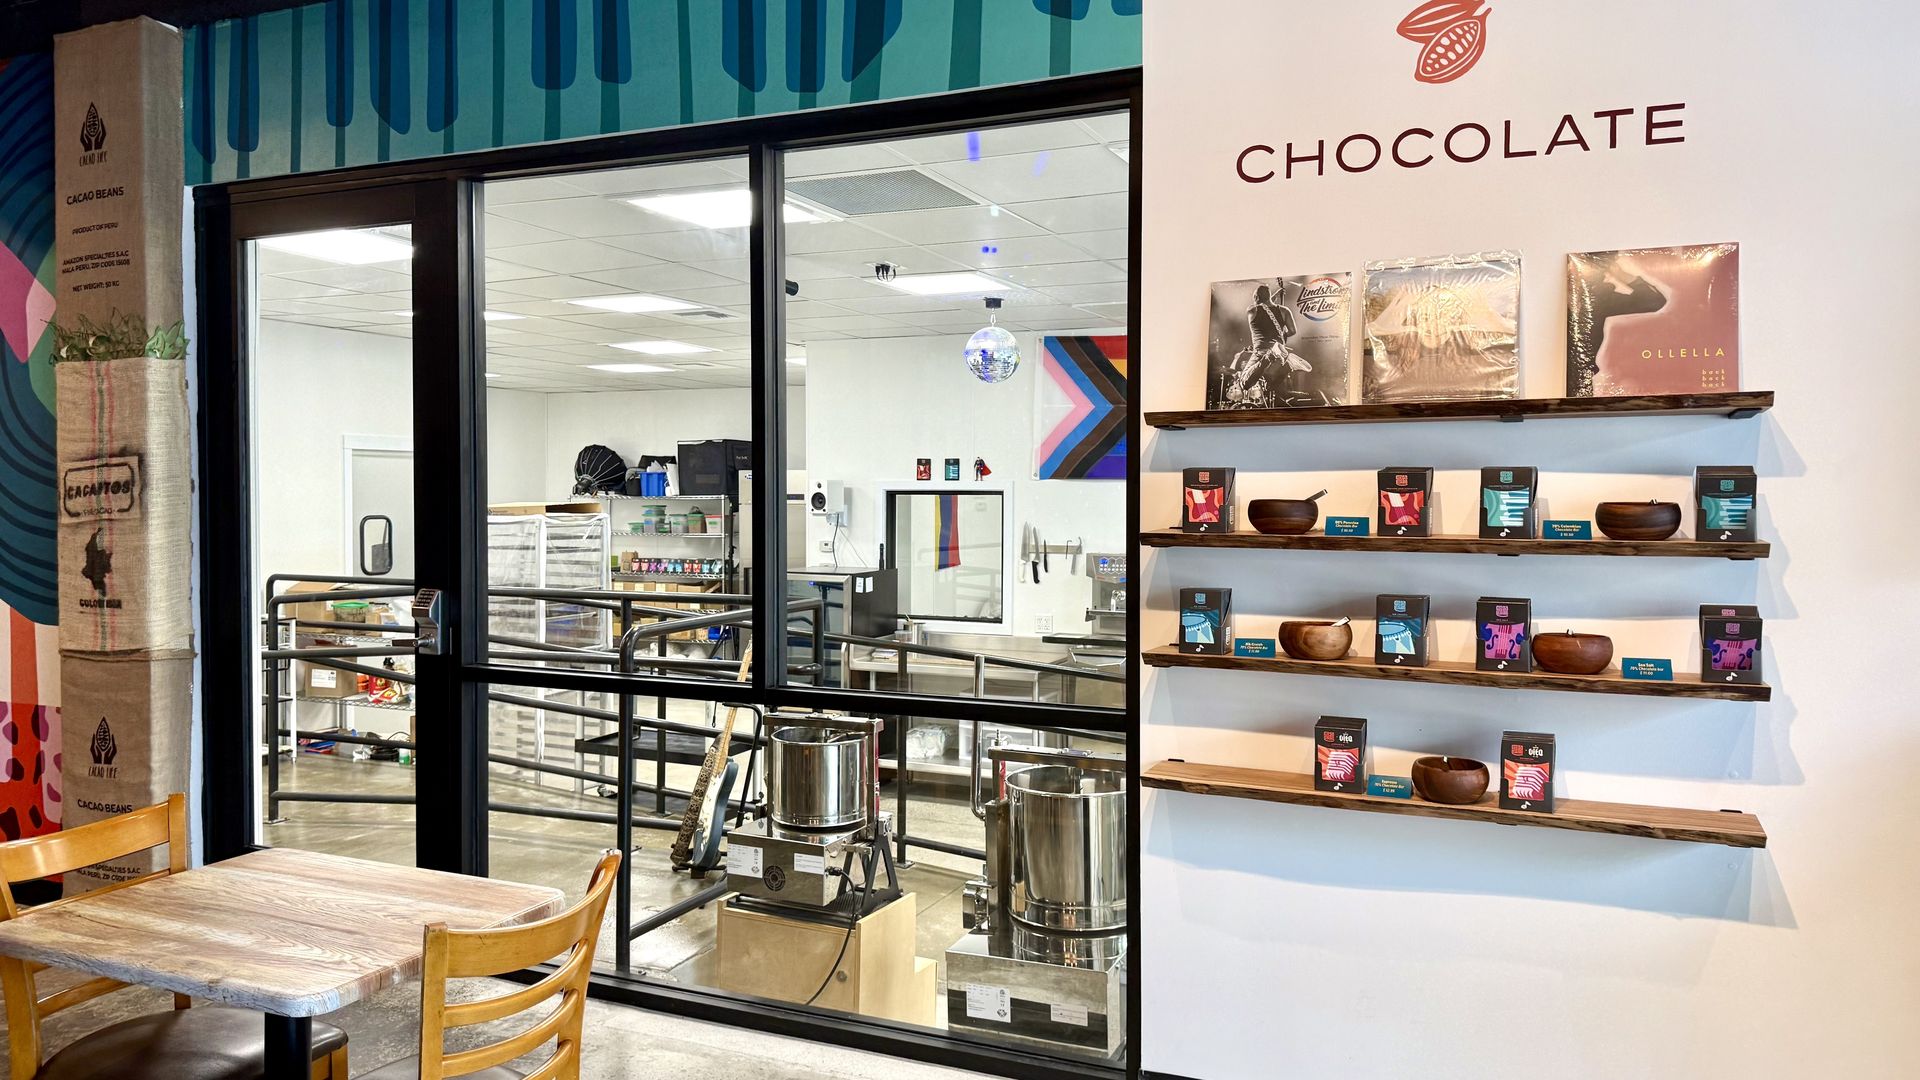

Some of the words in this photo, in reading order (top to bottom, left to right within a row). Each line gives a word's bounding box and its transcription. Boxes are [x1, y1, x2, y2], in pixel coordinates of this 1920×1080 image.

[1236, 102, 1687, 184] CHOCOLATE
[66, 191, 95, 205] CACAO
[96, 187, 124, 199] BEANS
[72, 225, 96, 235] PRODUCT
[104, 222, 119, 230] PERU
[63, 255, 84, 266] AMAZON
[101, 260, 115, 268] CODE
[72, 284, 83, 292] NET
[1296, 299, 1317, 315] The
[1641, 347, 1725, 359] OLLELLA
[88, 766, 105, 778] CACAO
[105, 767, 119, 779] LIFE
[77, 799, 104, 812] CACAO
[105, 804, 133, 814] BEANS
